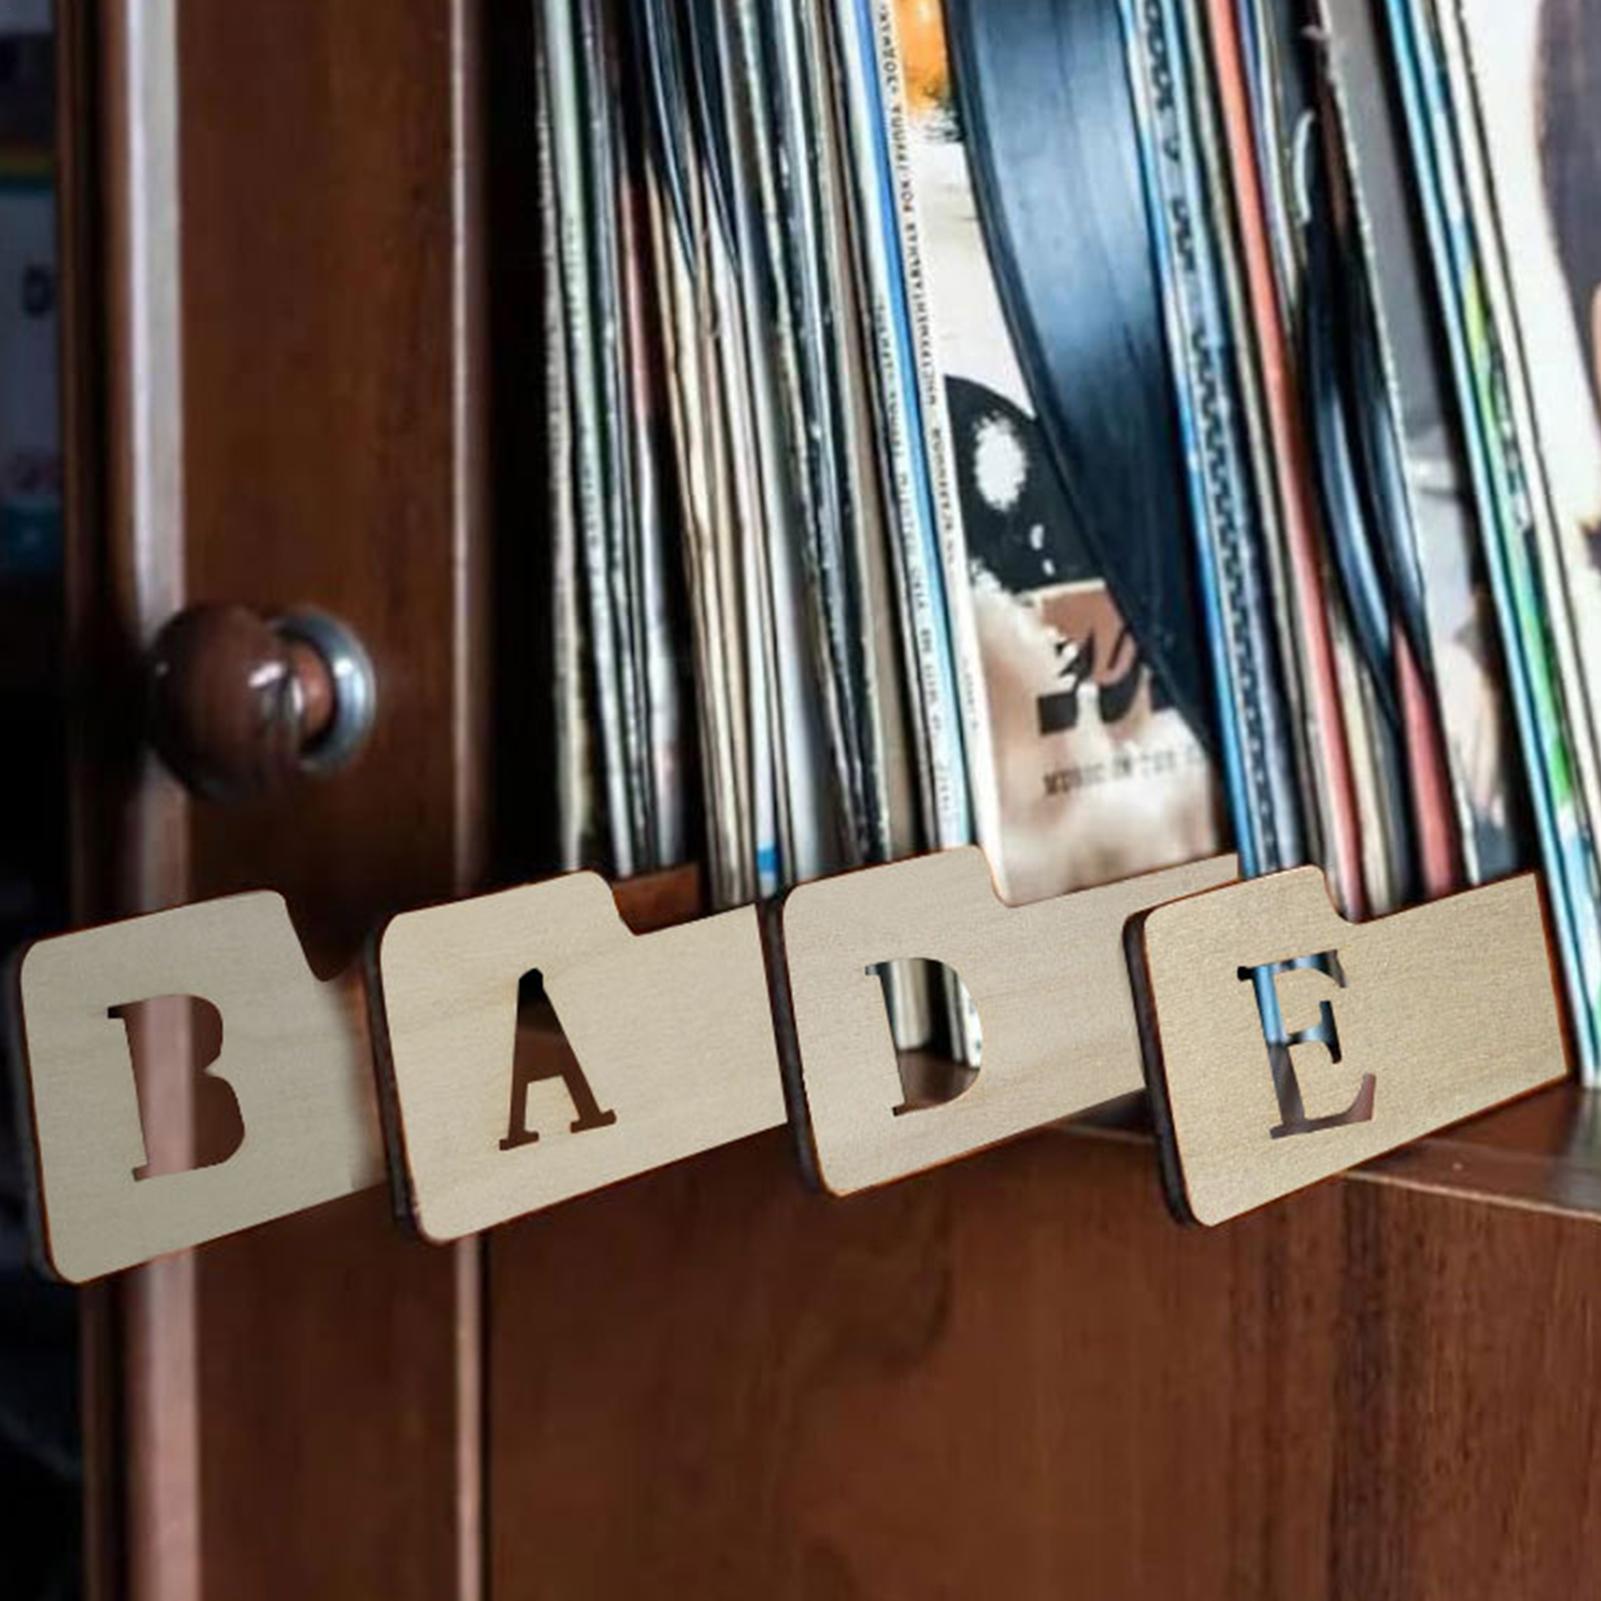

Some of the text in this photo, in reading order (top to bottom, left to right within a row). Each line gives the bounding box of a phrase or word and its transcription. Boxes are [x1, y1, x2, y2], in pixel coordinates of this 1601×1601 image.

[107, 993, 246, 1182] B
[499, 967, 617, 1151] A
[865, 957, 983, 1117] D
[1237, 949, 1376, 1139] E
